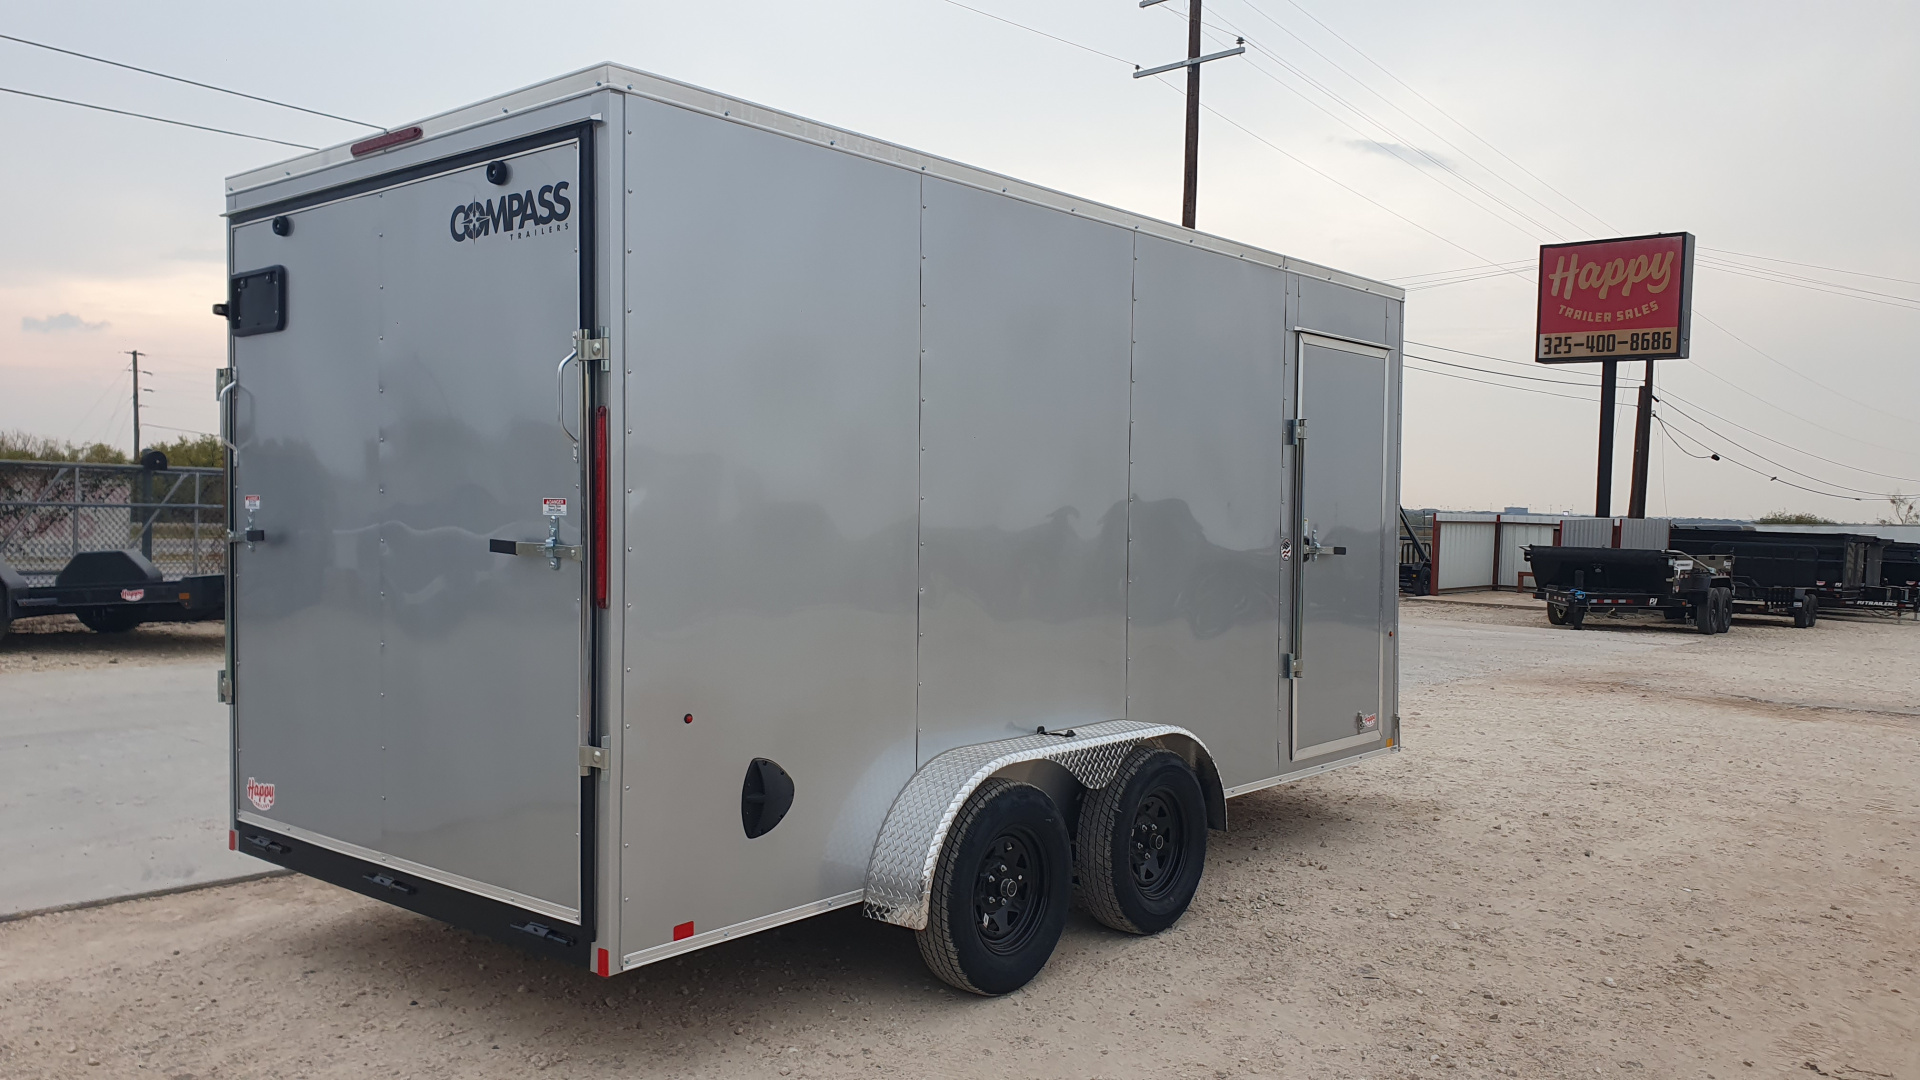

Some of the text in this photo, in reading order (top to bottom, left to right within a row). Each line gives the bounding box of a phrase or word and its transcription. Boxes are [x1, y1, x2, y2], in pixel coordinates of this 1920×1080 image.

[450, 181, 571, 243] COMPASS
[510, 222, 569, 241] TRAILERS
[1548, 251, 1675, 300] Happy
[1558, 300, 1659, 323] TRAILER SALES
[1543, 331, 1672, 355] 325-400-8686
[248, 778, 275, 805] Happy
